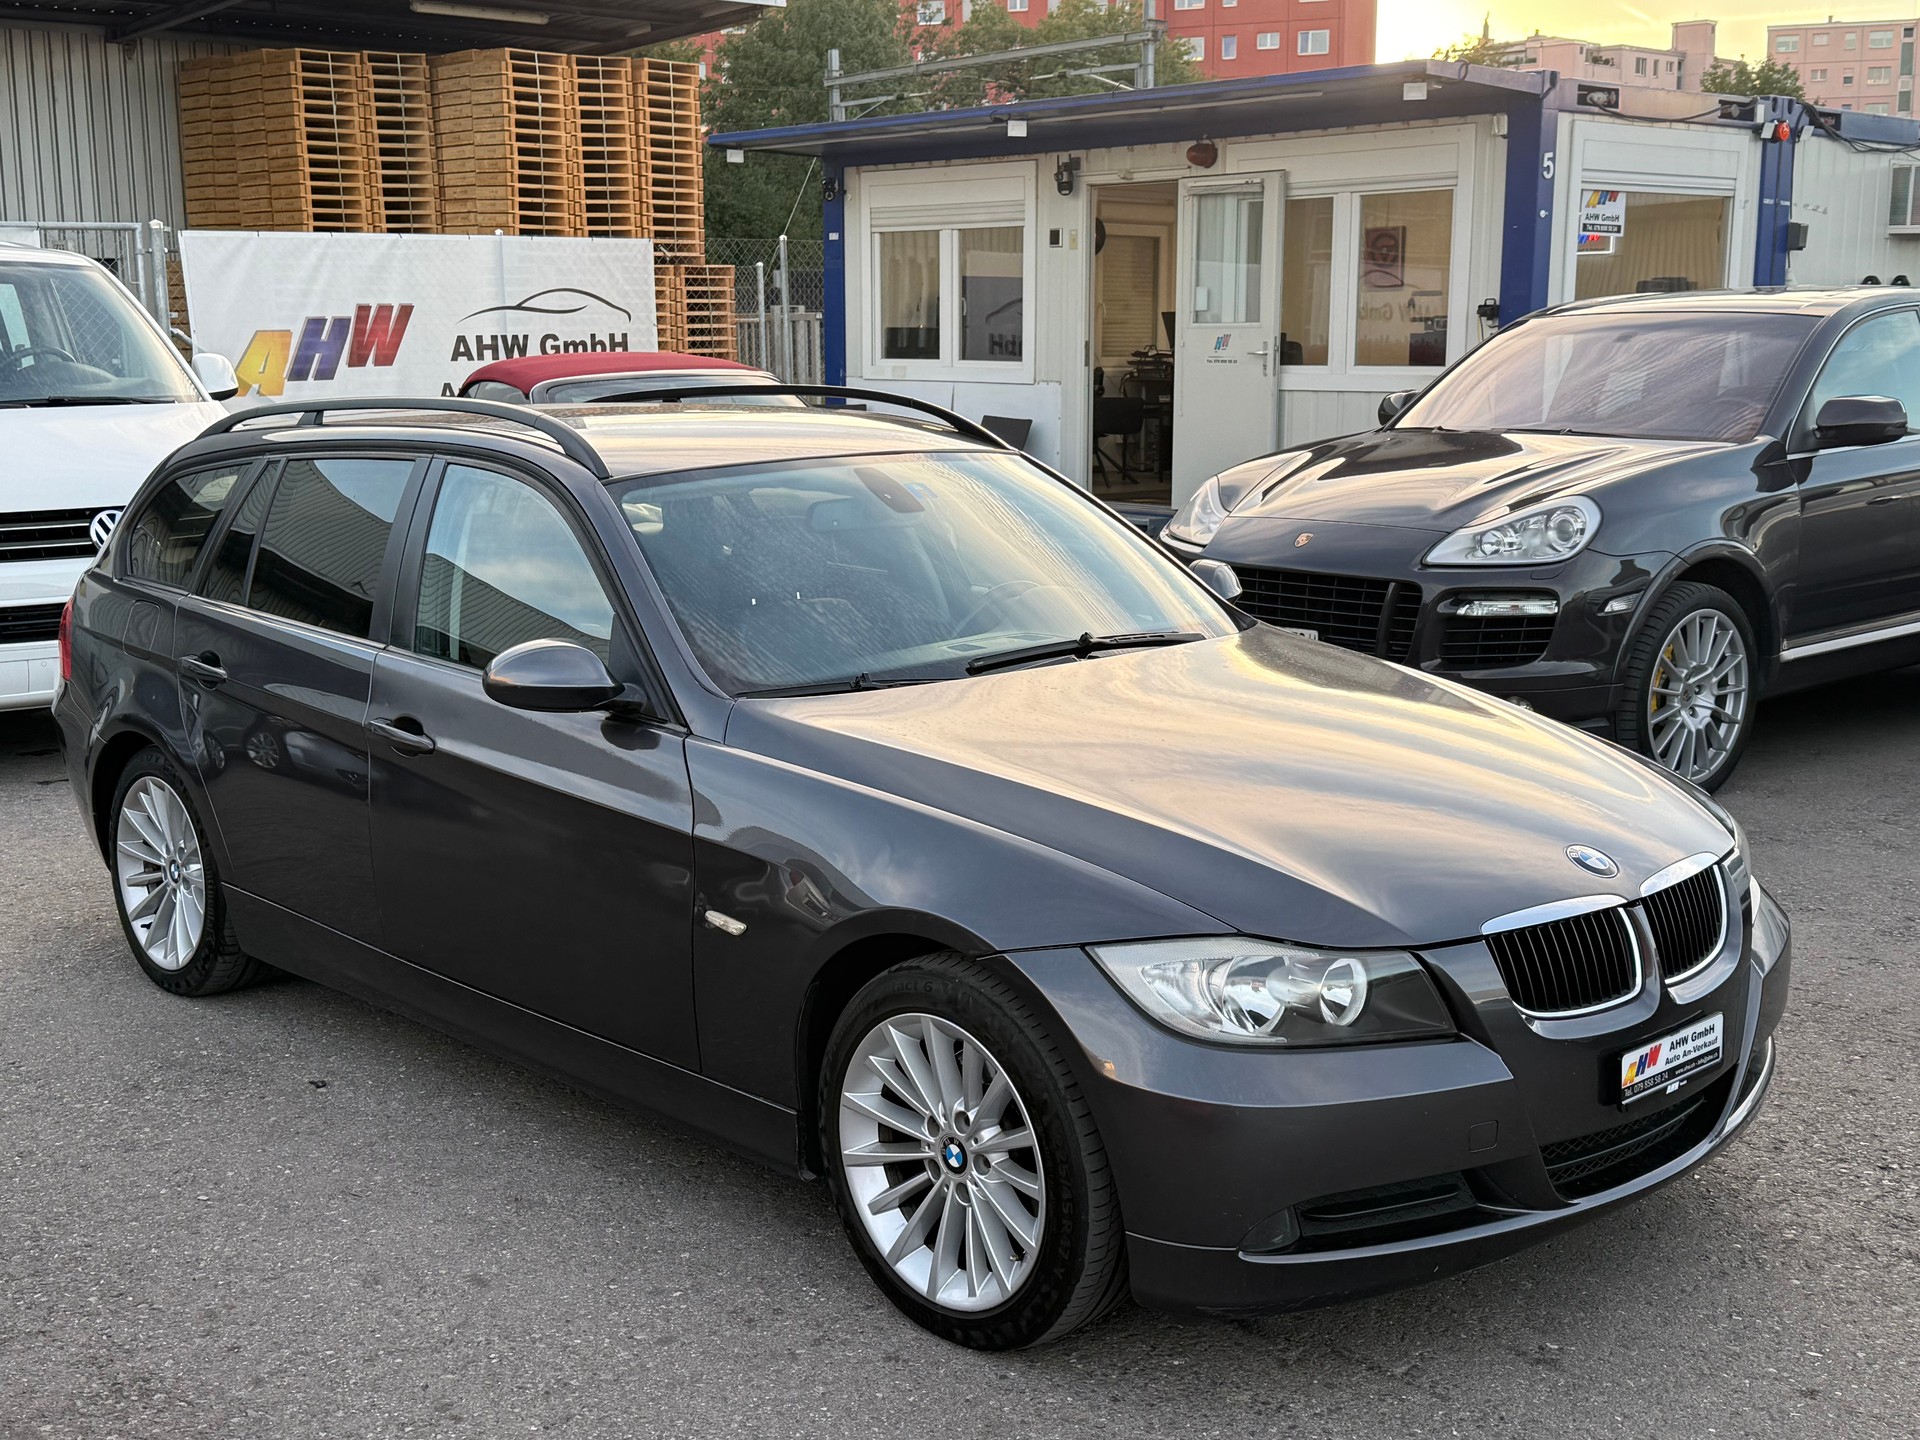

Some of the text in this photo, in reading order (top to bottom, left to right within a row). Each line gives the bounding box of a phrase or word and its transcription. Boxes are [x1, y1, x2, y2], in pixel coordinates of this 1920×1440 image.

[1543, 152, 1554, 179] 5
[1585, 213, 1619, 222] AHW GmbH
[236, 303, 415, 397] AHW
[451, 333, 629, 361] AHW GmbH
[1665, 1036, 1718, 1066] Auto An-Verkauf
[1669, 1024, 1715, 1052] AHW GmbH
[1623, 1043, 1663, 1087] AHW
[1624, 1088, 1633, 1097] Tel.
[1633, 1083, 1643, 1093] 079
[1654, 1074, 1661, 1084] 58
[1662, 1071, 1669, 1081] 24
